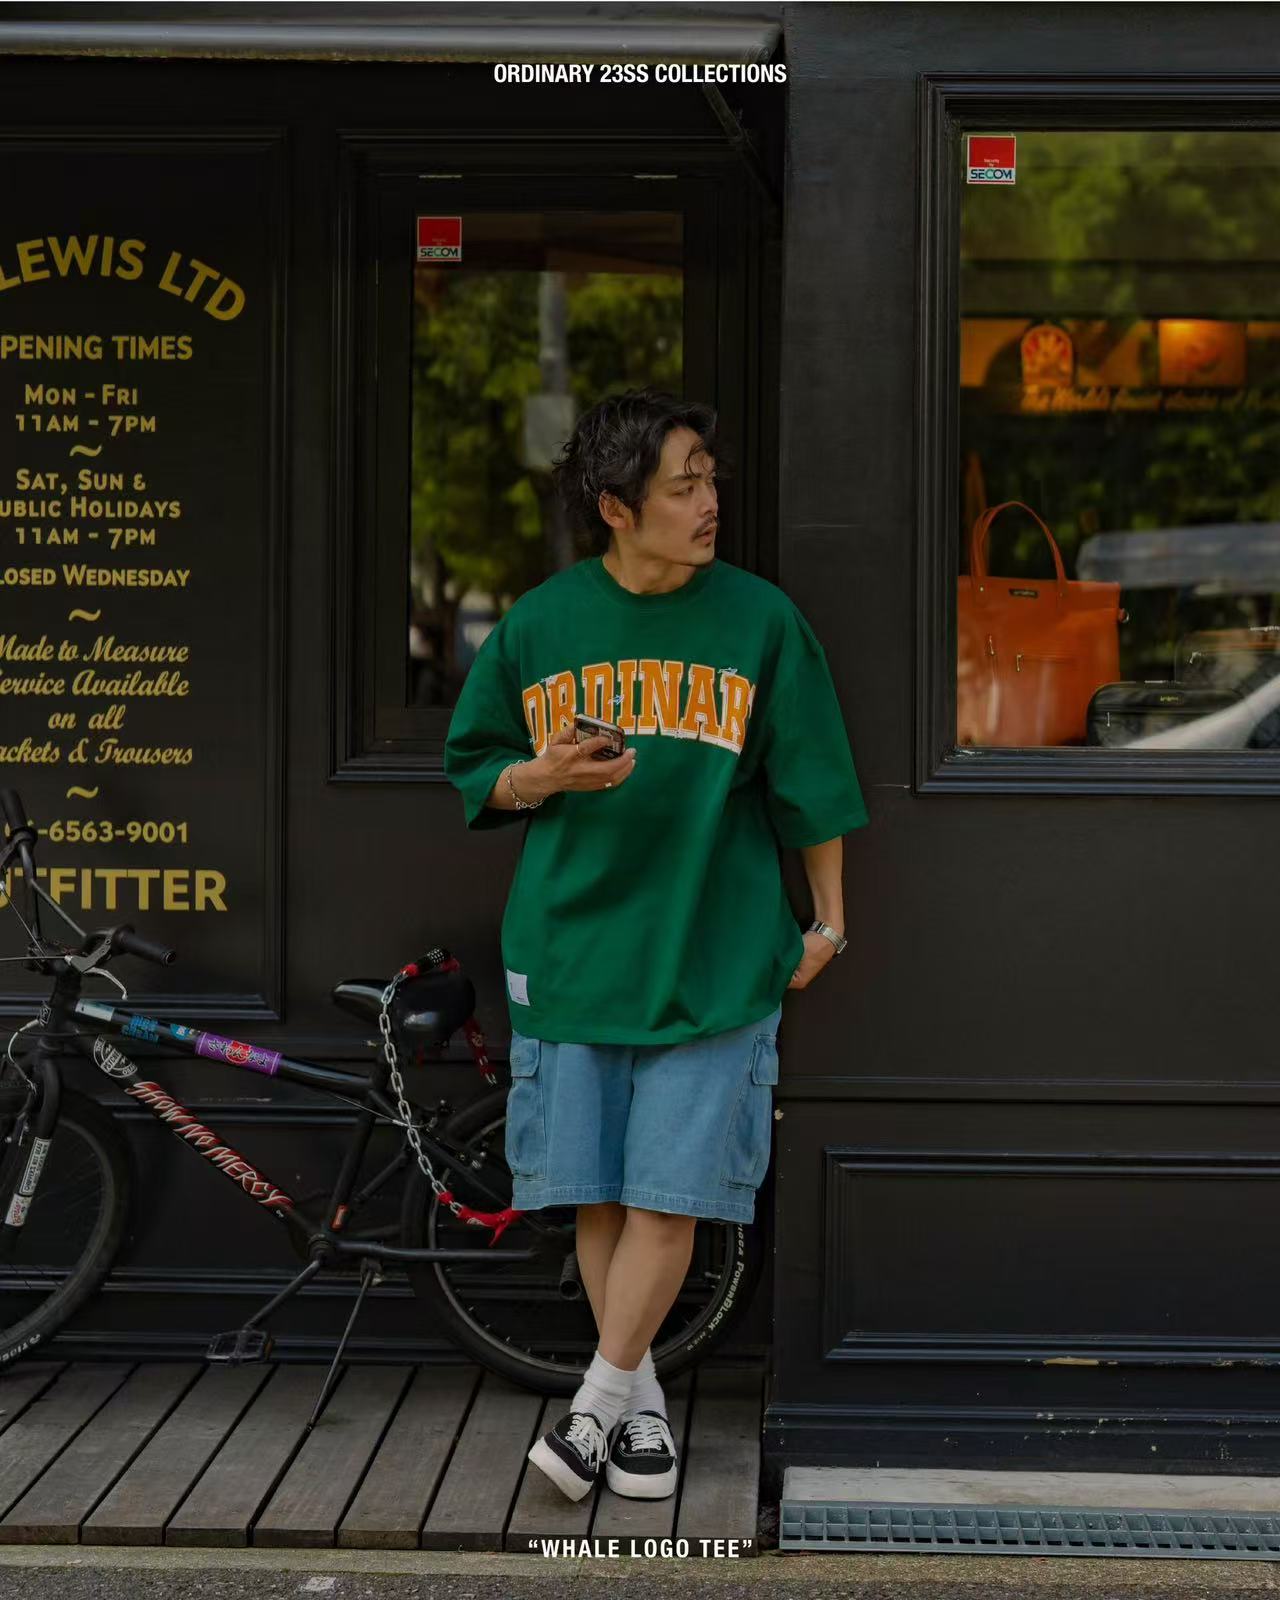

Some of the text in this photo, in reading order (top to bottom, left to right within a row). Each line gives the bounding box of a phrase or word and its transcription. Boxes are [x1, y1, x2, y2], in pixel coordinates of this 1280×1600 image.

[970, 169, 1013, 180] SECOM
[420, 247, 458, 257] SECOM
[158, 251, 246, 321] LTD
[111, 335, 193, 360] TIMES
[15, 414, 79, 432] 11AM
[108, 415, 156, 437] 7PM
[133, 473, 146, 491] &
[15, 527, 79, 545] 11AM
[108, 527, 156, 550] 7PM
[57, 639, 79, 662] to
[82, 635, 189, 663] Measure
[0, 668, 190, 697] ervice Available
[48, 704, 127, 731] on all
[522, 658, 757, 757] ORDINAR
[68, 738, 89, 764] &
[95, 738, 193, 765] Trousers
[174, 1122, 217, 1147] NO
[201, 1145, 297, 1210] MERCY
